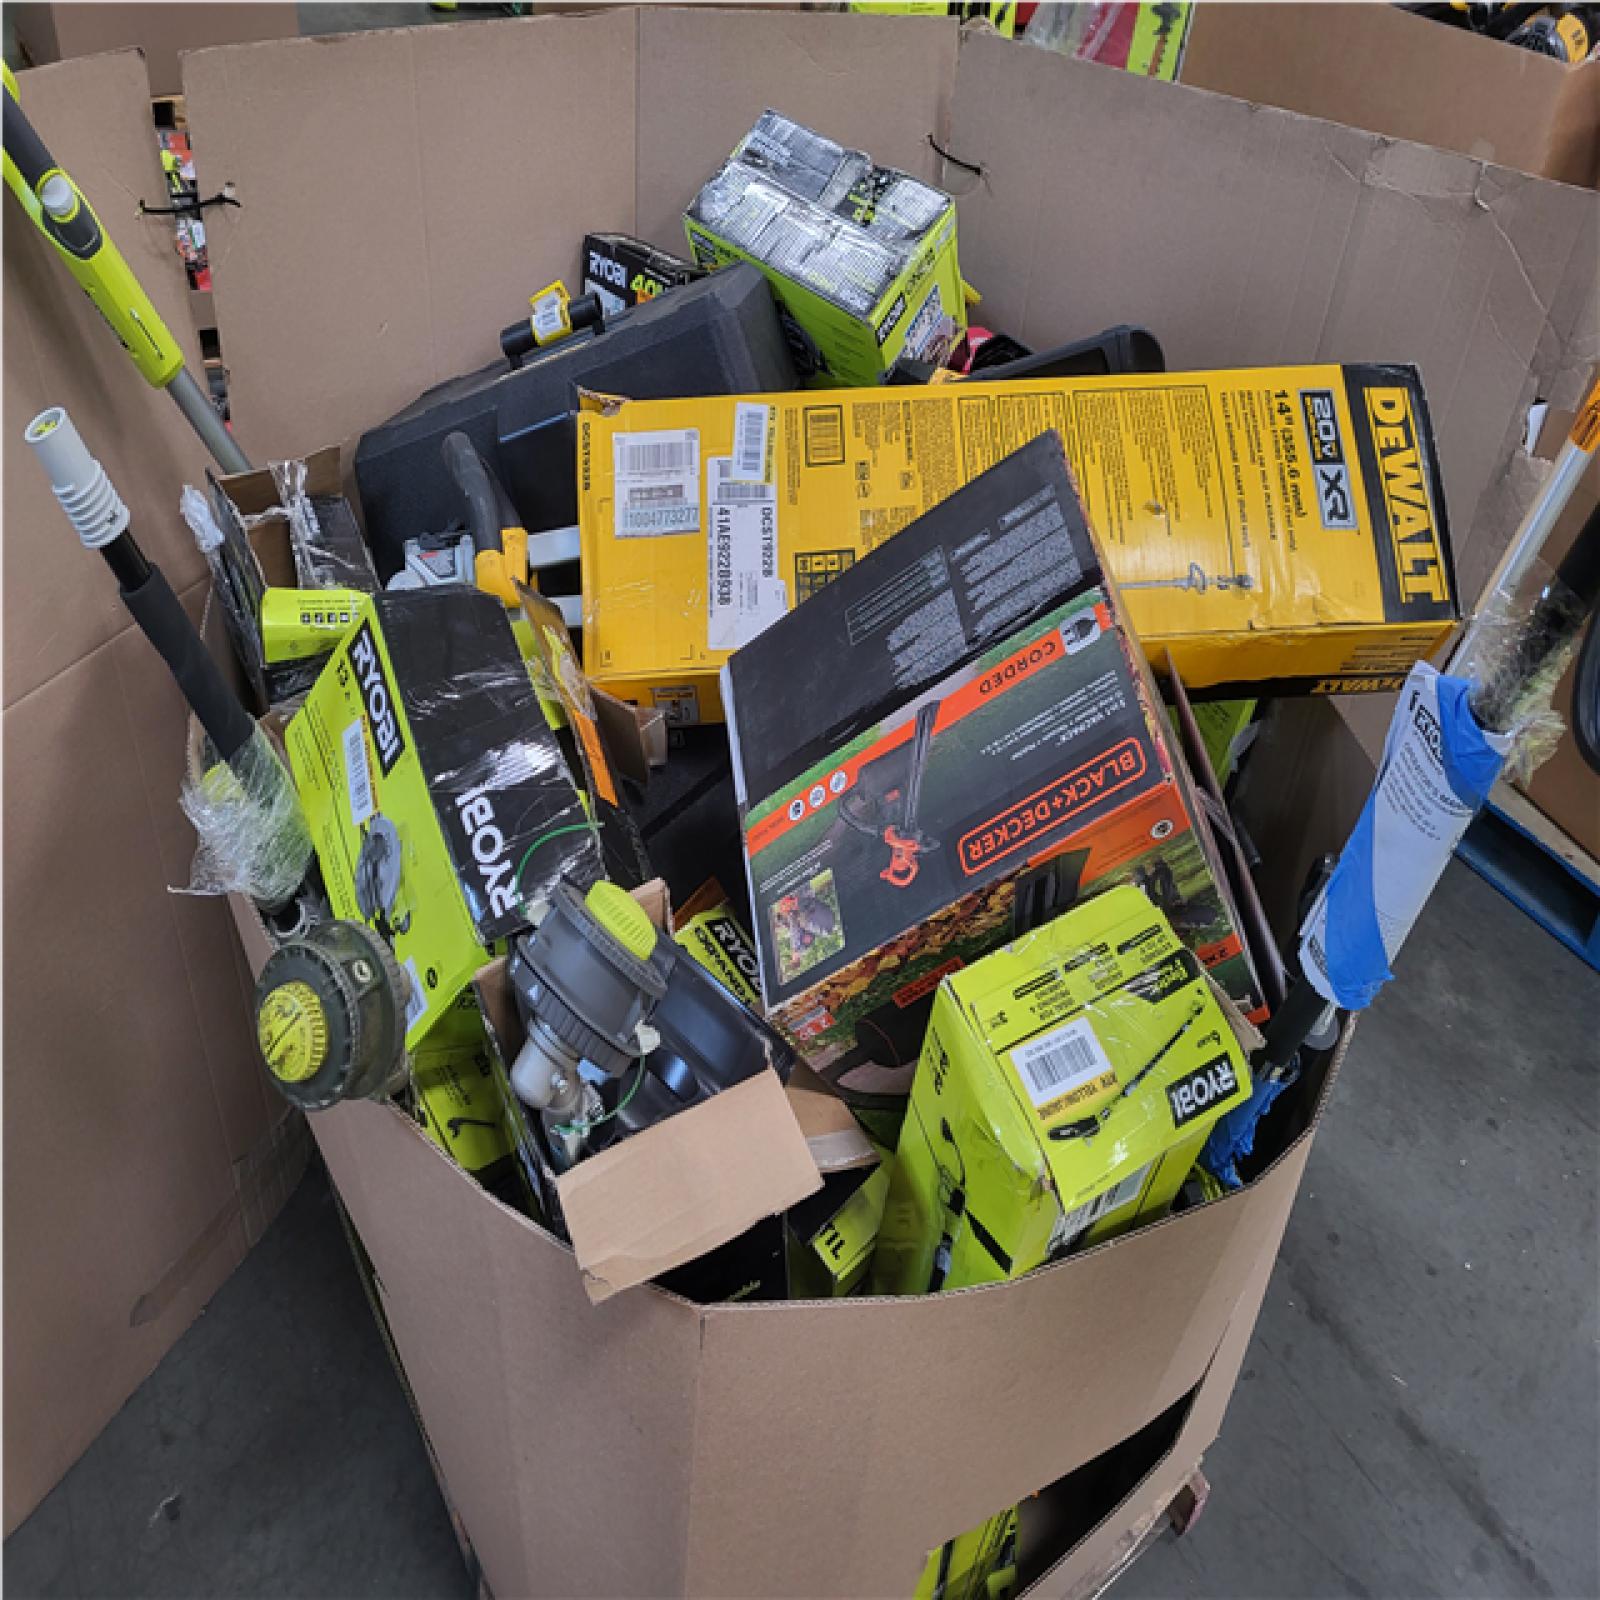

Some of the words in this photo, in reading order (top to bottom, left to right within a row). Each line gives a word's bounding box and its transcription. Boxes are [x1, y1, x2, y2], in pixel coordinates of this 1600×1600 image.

[1319, 469, 1349, 521] XR
[1363, 387, 1449, 603] DEWALT
[353, 628, 401, 761] RYOBI
[980, 640, 1057, 696] CORDED
[455, 789, 520, 919] RYOBI
[966, 753, 1138, 863] BLACK+DECKER
[1169, 1060, 1236, 1119] RYOBI
